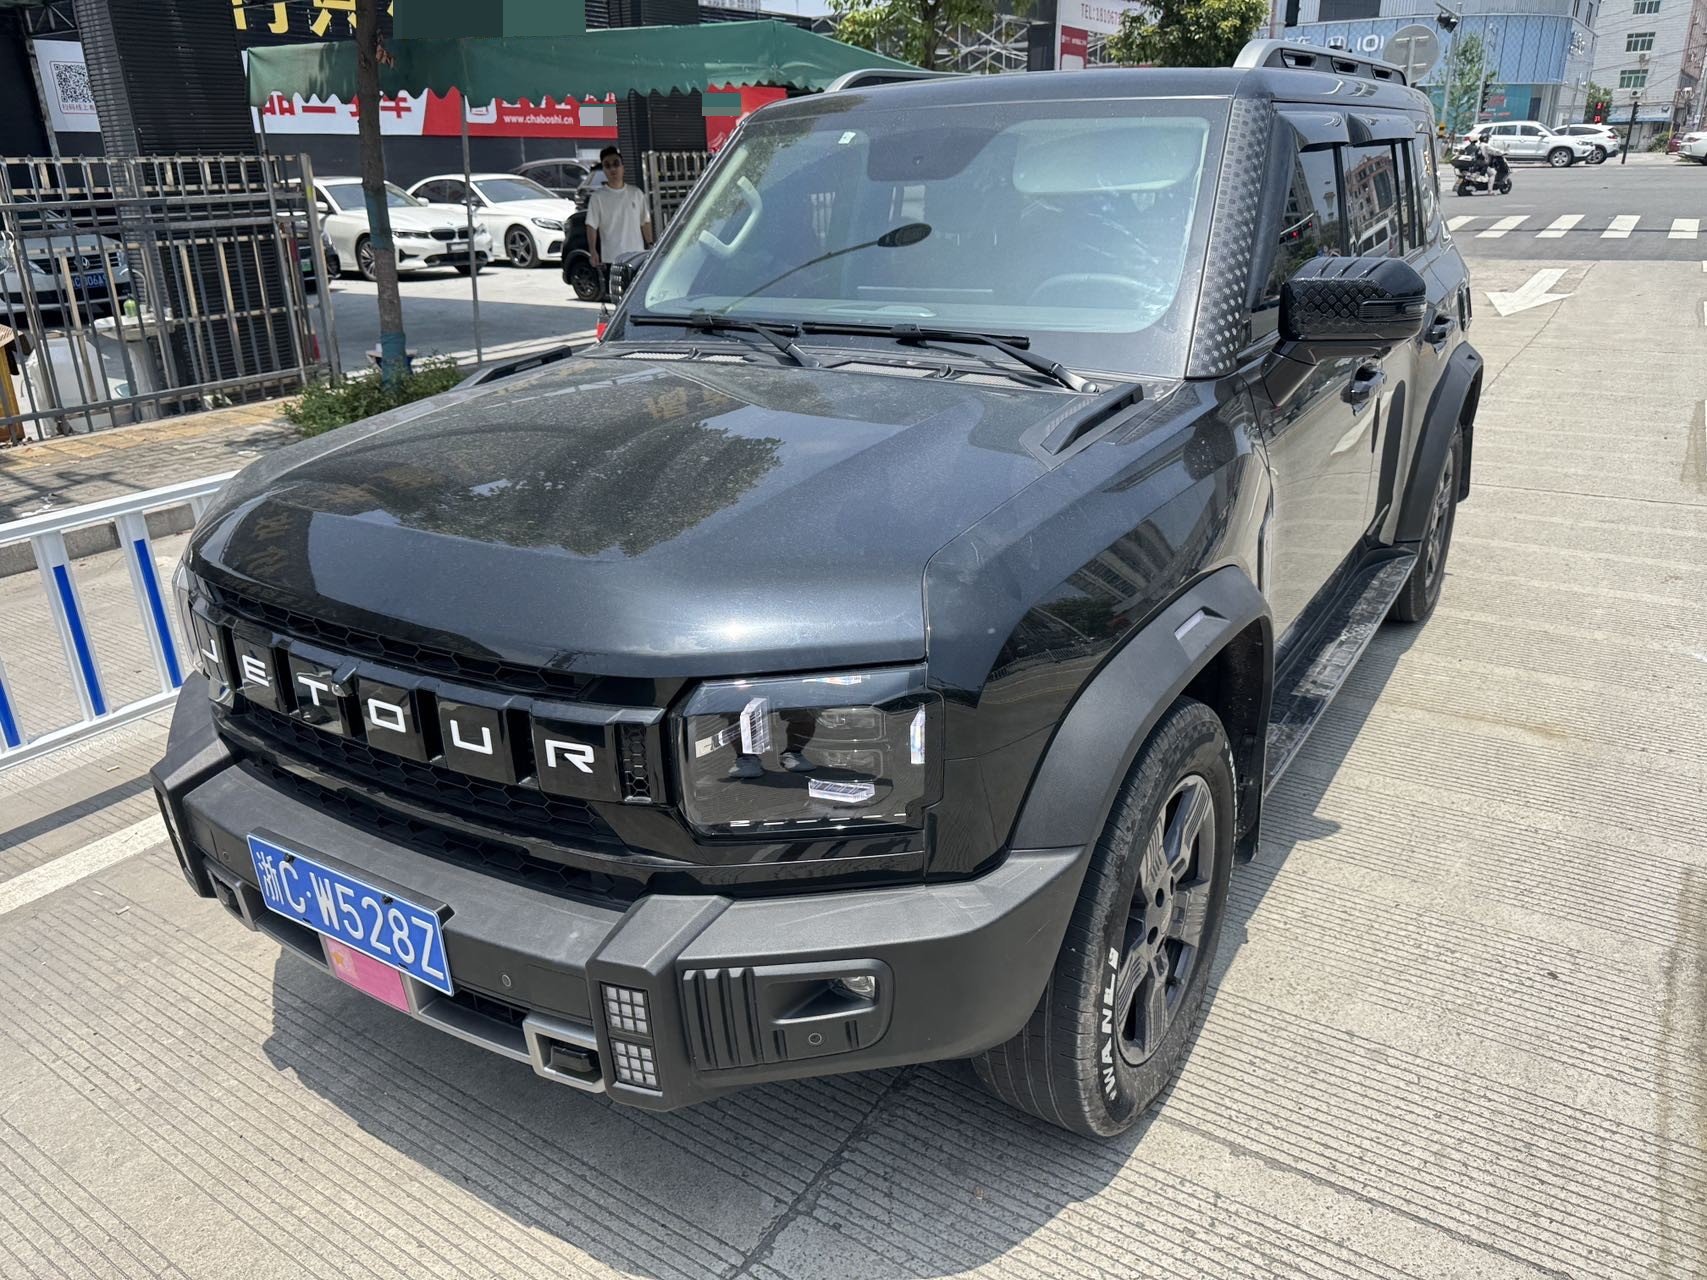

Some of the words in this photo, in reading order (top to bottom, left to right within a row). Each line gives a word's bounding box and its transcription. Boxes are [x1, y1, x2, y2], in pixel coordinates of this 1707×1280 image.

[503, 114, 574, 125] www.chaboshi.cn
[201, 638, 595, 775] JETOUR
[256, 851, 445, 981] 浙C·W528Z
